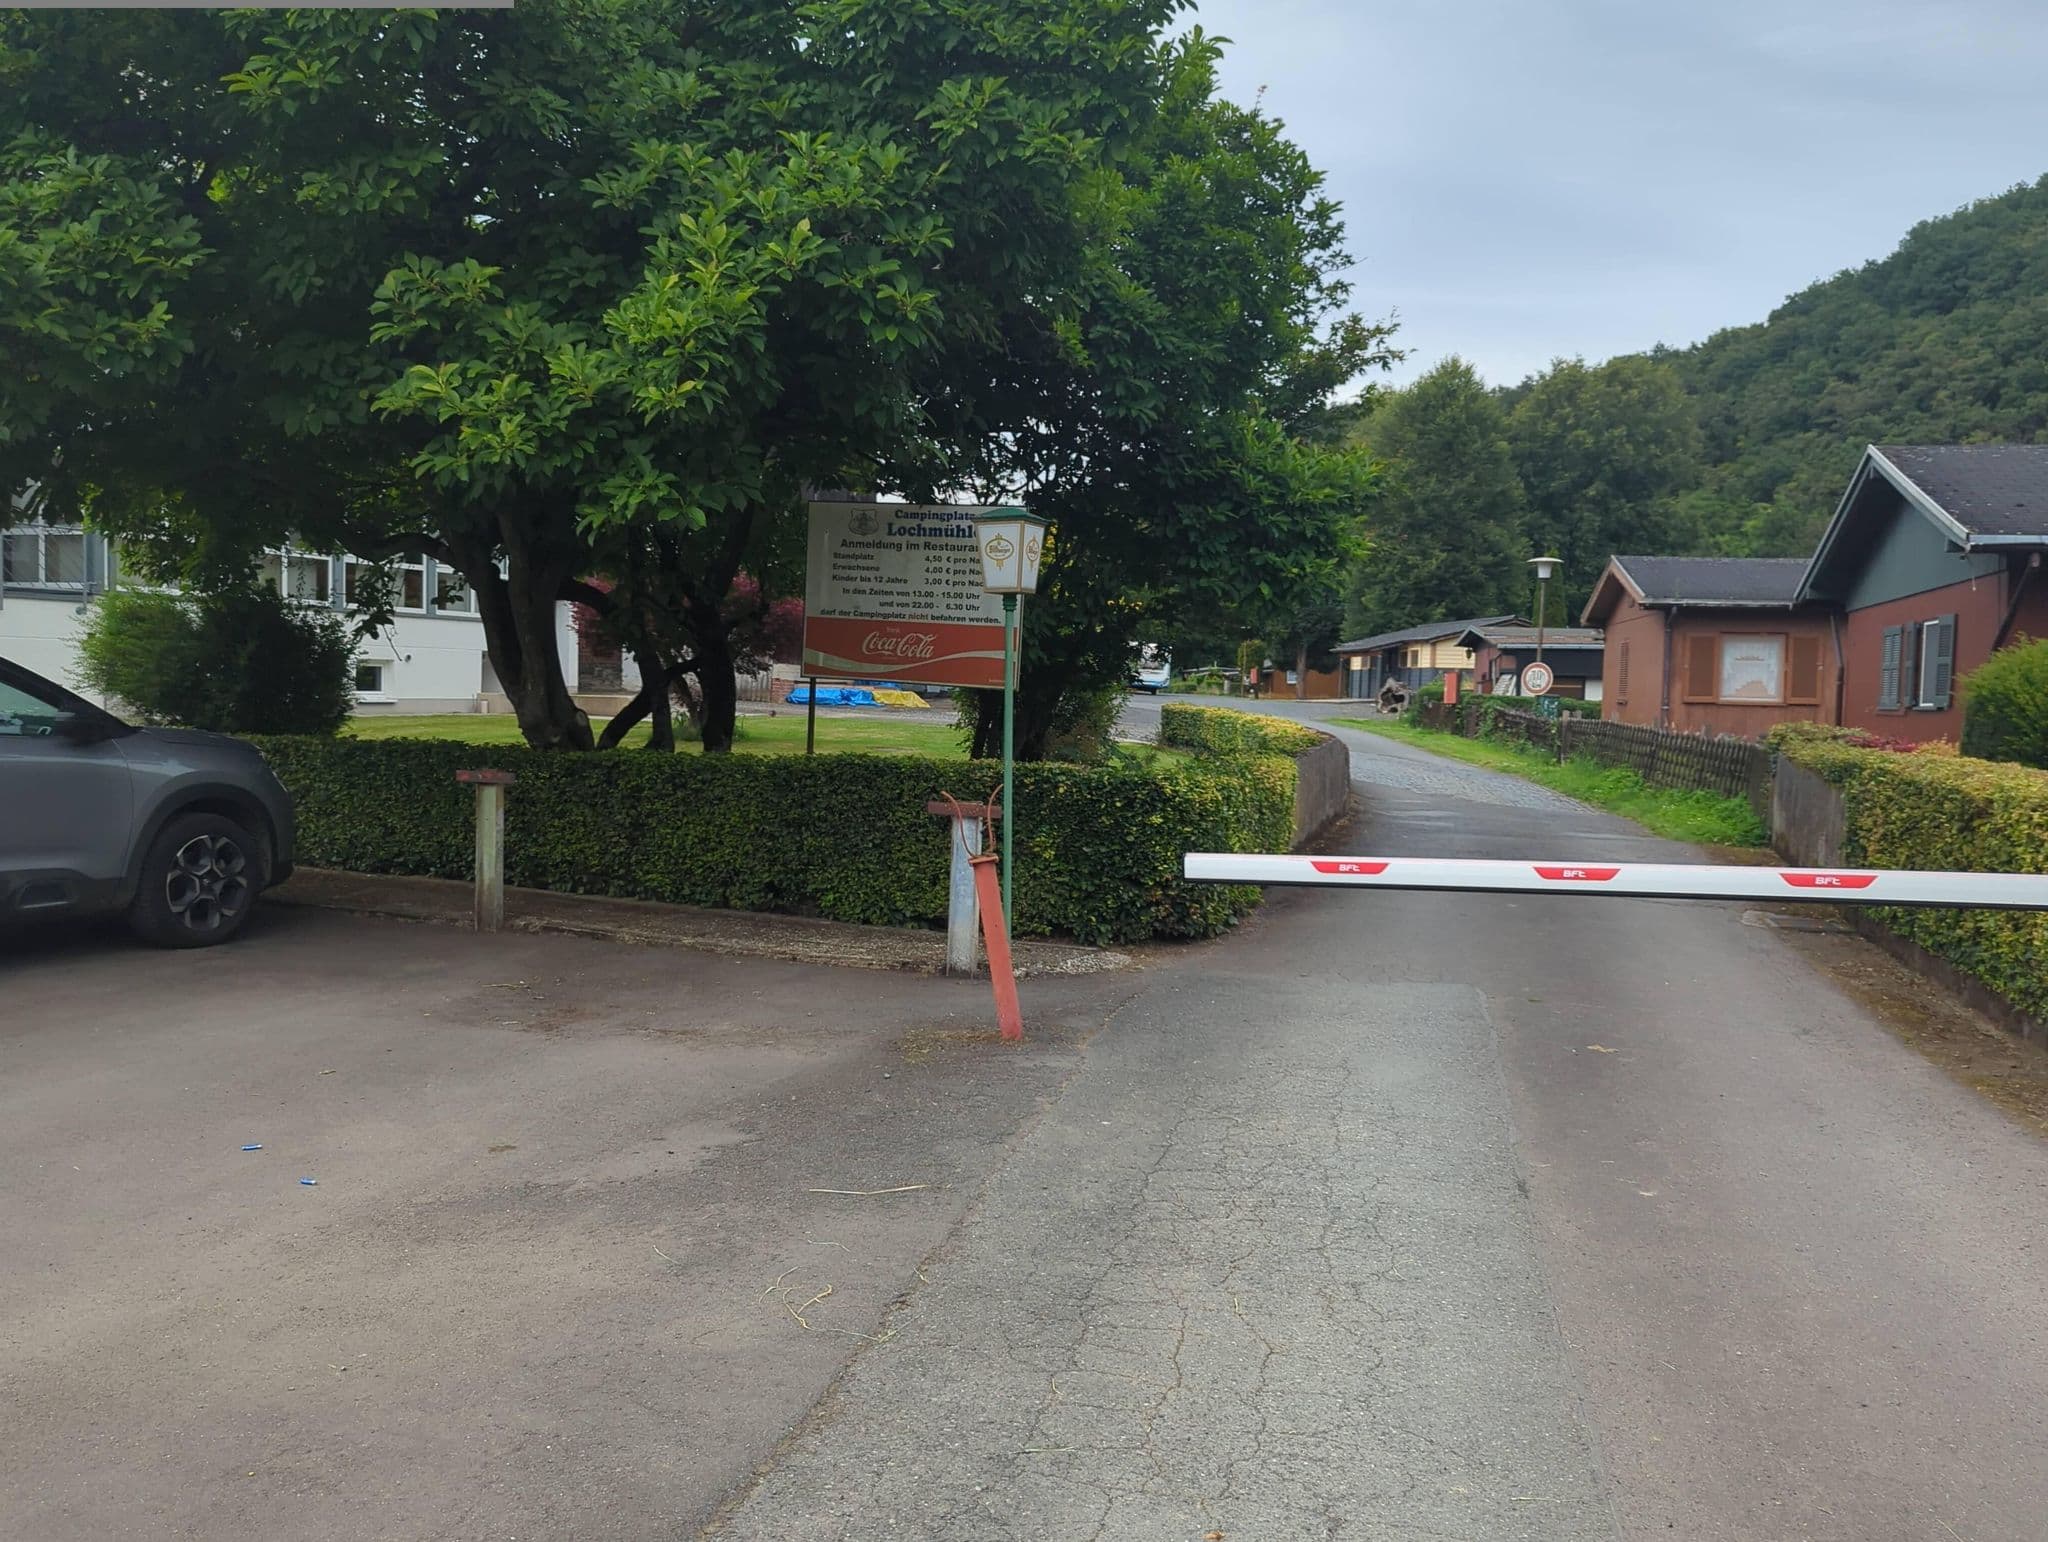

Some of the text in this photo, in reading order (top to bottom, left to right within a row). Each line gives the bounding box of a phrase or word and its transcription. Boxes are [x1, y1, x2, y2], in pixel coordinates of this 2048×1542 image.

[840, 539, 902, 552] Anmeldung
[906, 541, 920, 551] im
[832, 552, 875, 561] Standplatz
[924, 555, 943, 563] 4,50
[953, 557, 968, 565] pro
[832, 562, 880, 571] Erwachsene
[924, 566, 943, 575] 4,00
[832, 574, 858, 582] Kinder
[885, 576, 908, 584] Jahre
[842, 587, 850, 595] In
[869, 588, 894, 596] Zeiten
[912, 590, 934, 598] 13.00
[941, 592, 963, 600] 15.00
[966, 592, 981, 600] Uhr
[820, 608, 1001, 624] darf der Campingplatz nicht befahren werden.
[862, 631, 936, 658] Coca-Cola
